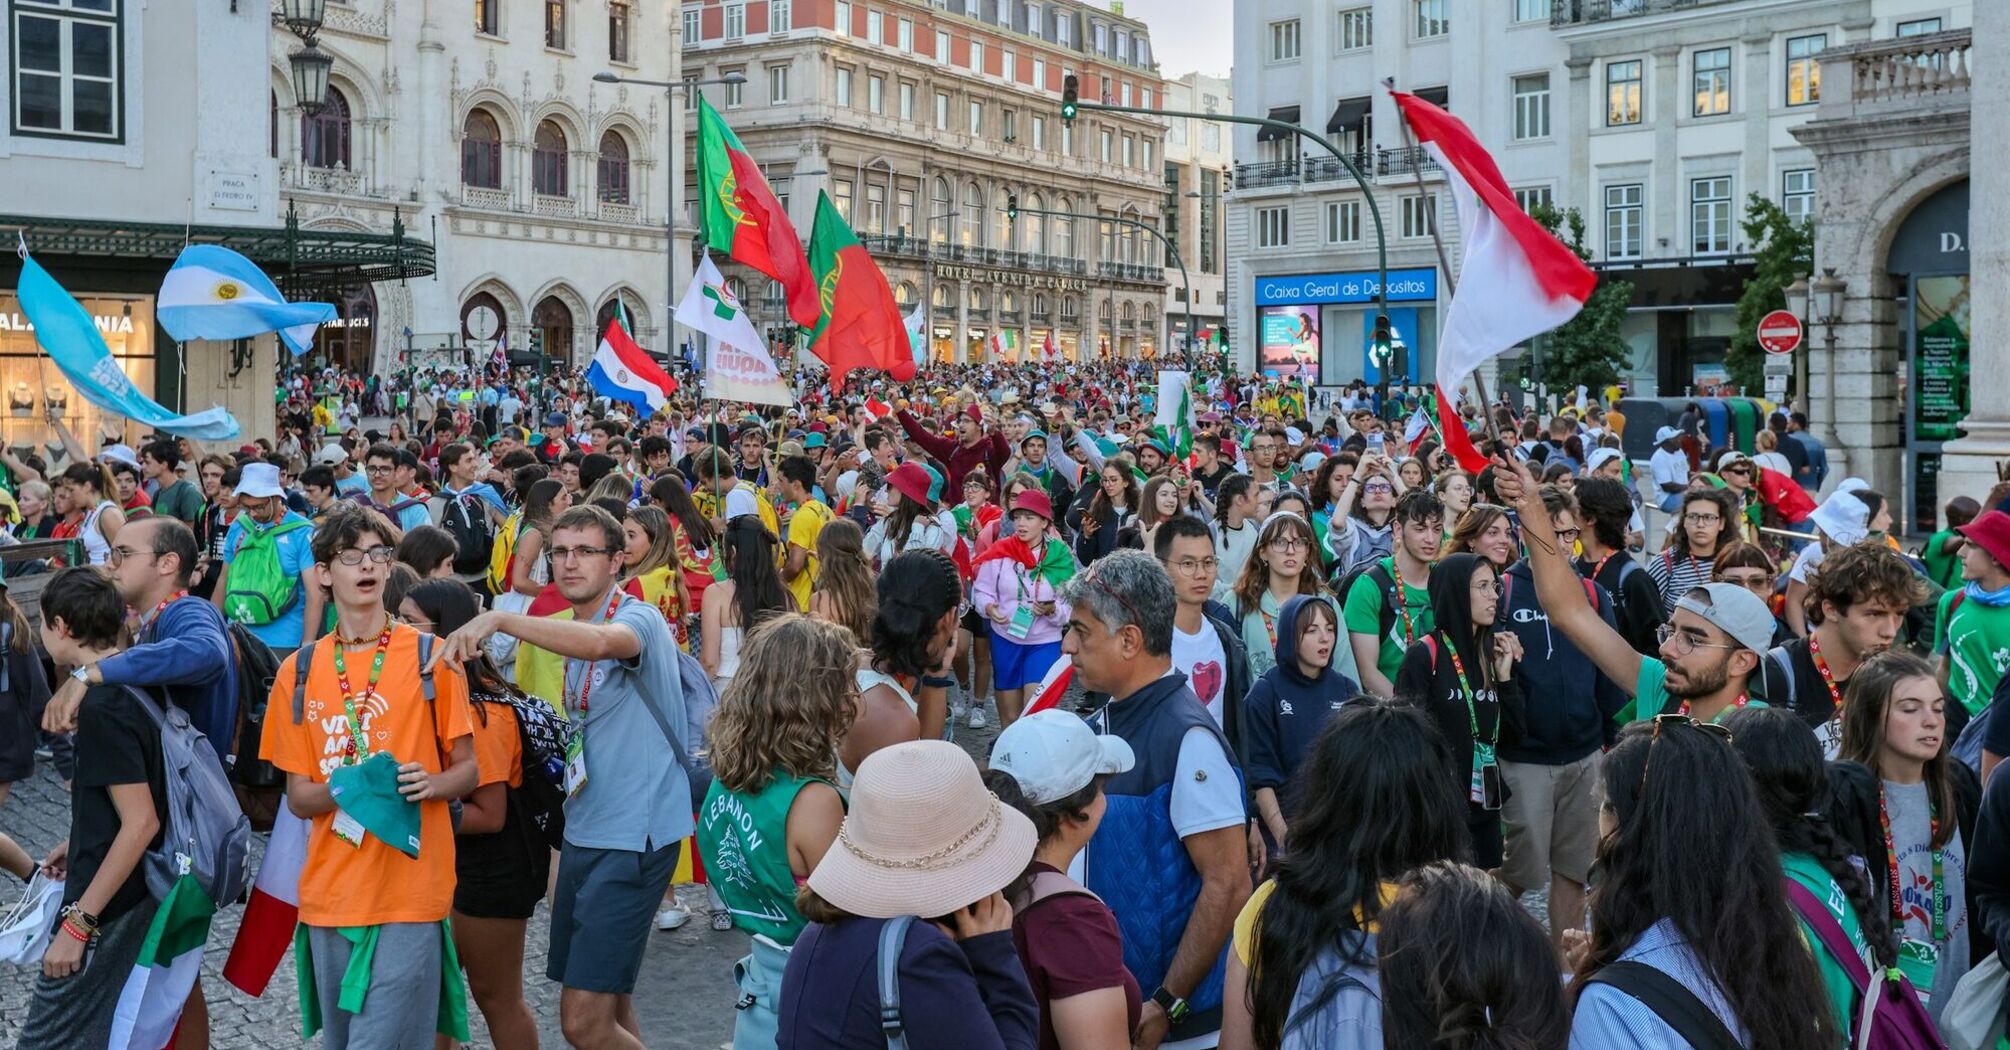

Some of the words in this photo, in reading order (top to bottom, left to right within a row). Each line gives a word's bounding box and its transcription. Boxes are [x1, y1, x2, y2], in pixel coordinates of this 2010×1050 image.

[937, 265, 977, 280] HOTEL
[986, 270, 1040, 287] AVENIDA
[1047, 277, 1088, 291] PALACE
[1264, 284, 1300, 299] Caixa
[1304, 281, 1339, 298] Geral
[1342, 281, 1359, 296] de
[704, 794, 763, 851] LEBANON
[1934, 881, 1944, 926] CASCAIS
